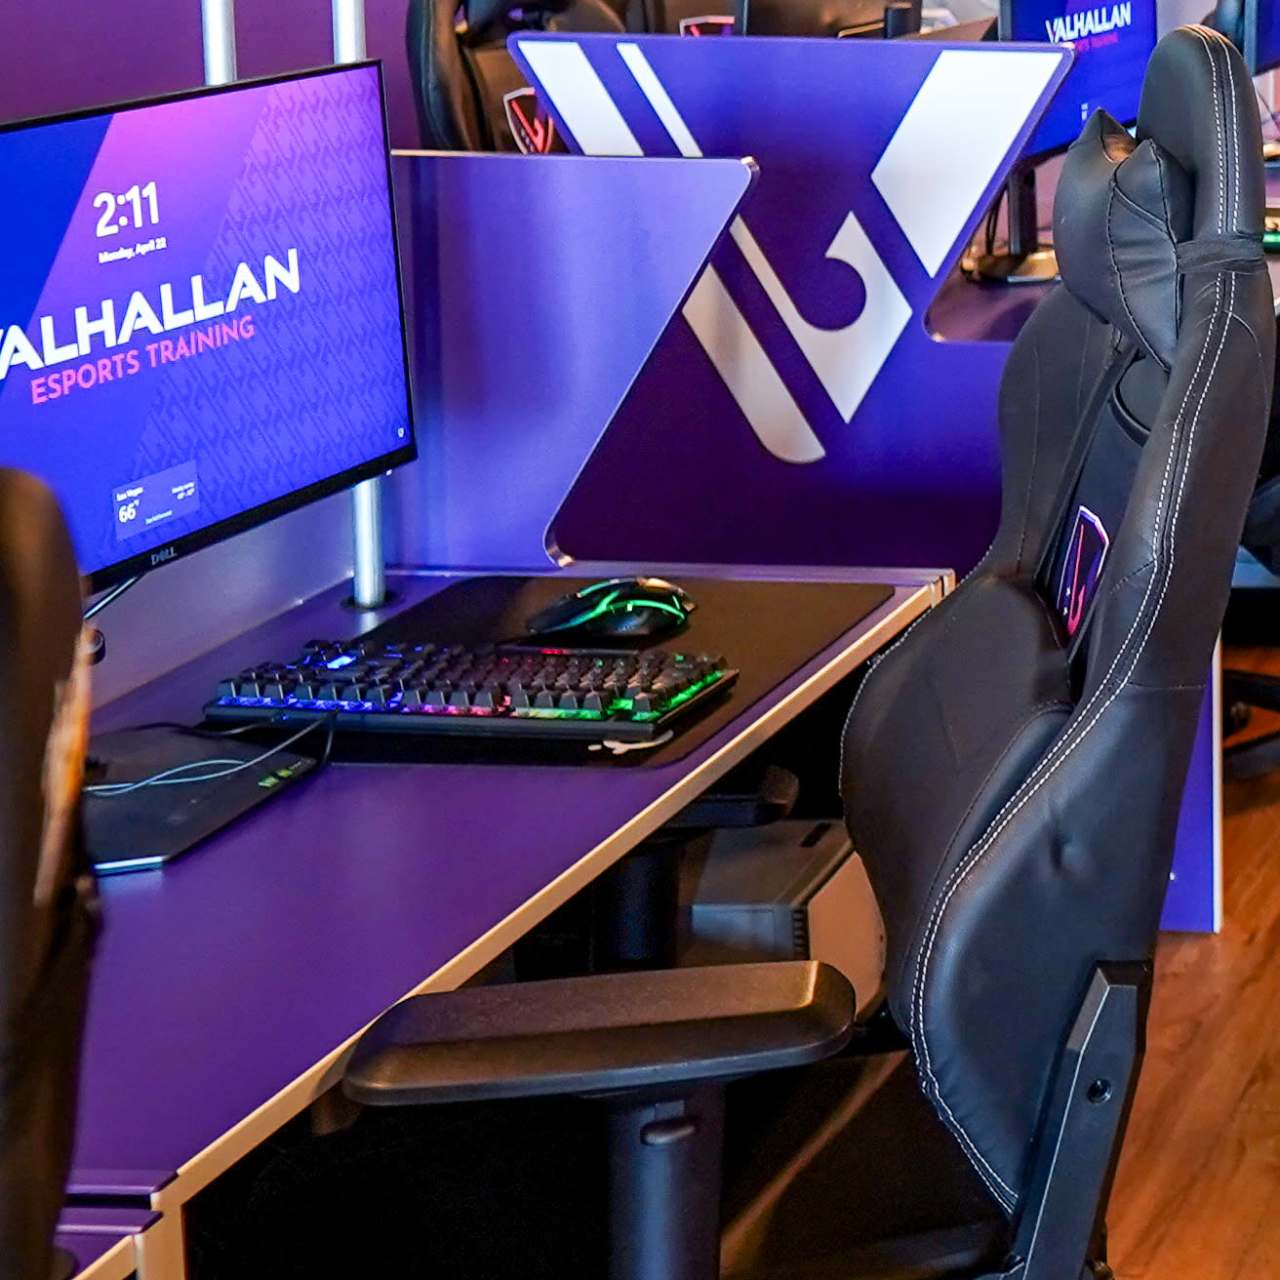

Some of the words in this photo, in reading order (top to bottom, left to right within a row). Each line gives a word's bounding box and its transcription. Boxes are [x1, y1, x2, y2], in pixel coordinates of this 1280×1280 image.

[1045, 1, 1132, 44] VALHALLAN
[92, 181, 160, 238] 2:11
[0, 248, 300, 381] ALHALLAN
[31, 350, 140, 405] ESPORTS
[146, 315, 256, 370] TRAINING
